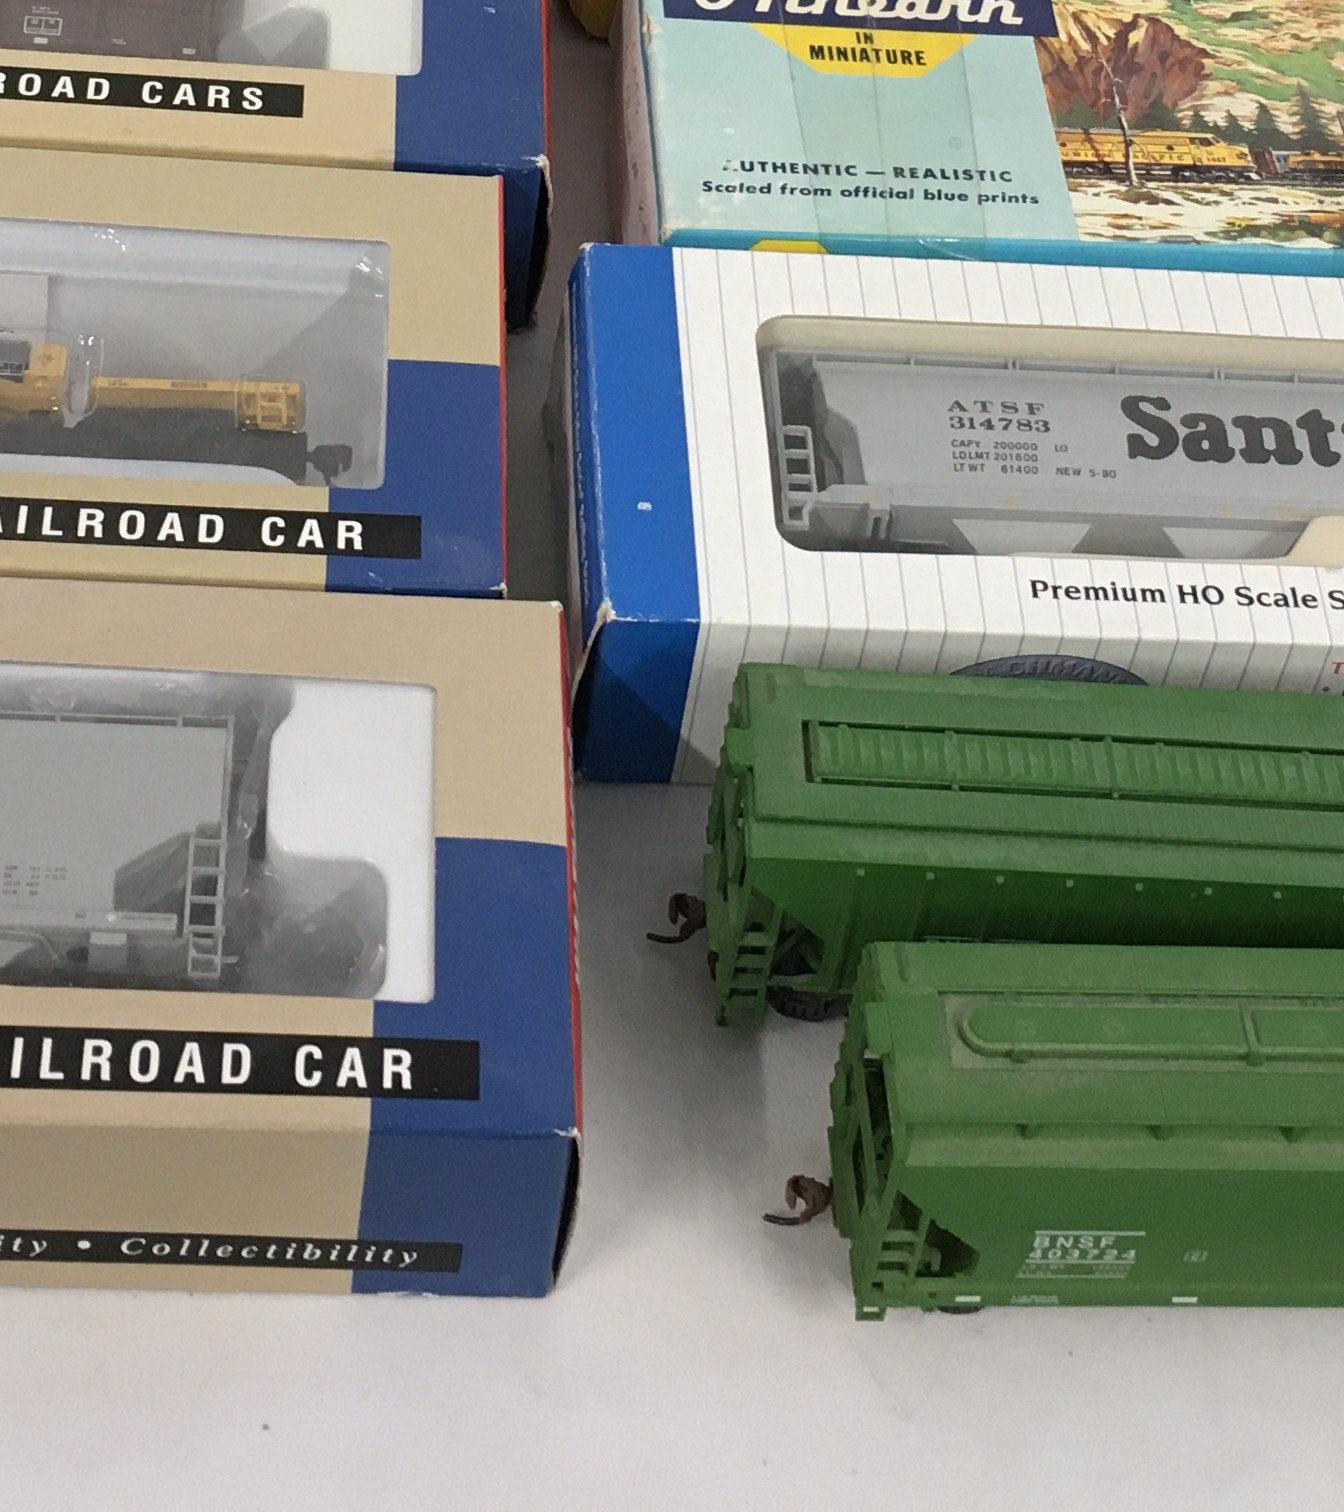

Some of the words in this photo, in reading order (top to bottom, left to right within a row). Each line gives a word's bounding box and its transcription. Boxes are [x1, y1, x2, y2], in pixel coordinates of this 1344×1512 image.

[855, 31, 875, 45] IN
[808, 45, 928, 67] MINIATURE
[140, 79, 265, 113] CARS
[892, 165, 1013, 184] REALISTIC
[701, 179, 773, 197] Scaled
[779, 183, 833, 199] from
[839, 185, 916, 202] official
[922, 189, 970, 206] blue
[976, 191, 1040, 208] prints
[946, 399, 1046, 416] ATSF
[948, 415, 1052, 434] 314783
[951, 439, 982, 449] CAPY
[993, 441, 1039, 452] 200000
[993, 452, 1039, 463] 201600
[1000, 464, 1039, 476] 61400
[1056, 467, 1082, 477] NEW
[259, 516, 366, 551] CAR
[1028, 579, 1167, 607] Premium
[1175, 583, 1225, 607] HO
[1234, 585, 1319, 611] Scale
[293, 1044, 415, 1092] CAR
[1033, 1234, 1117, 1249] BNSF
[118, 1236, 420, 1270] Collectibility
